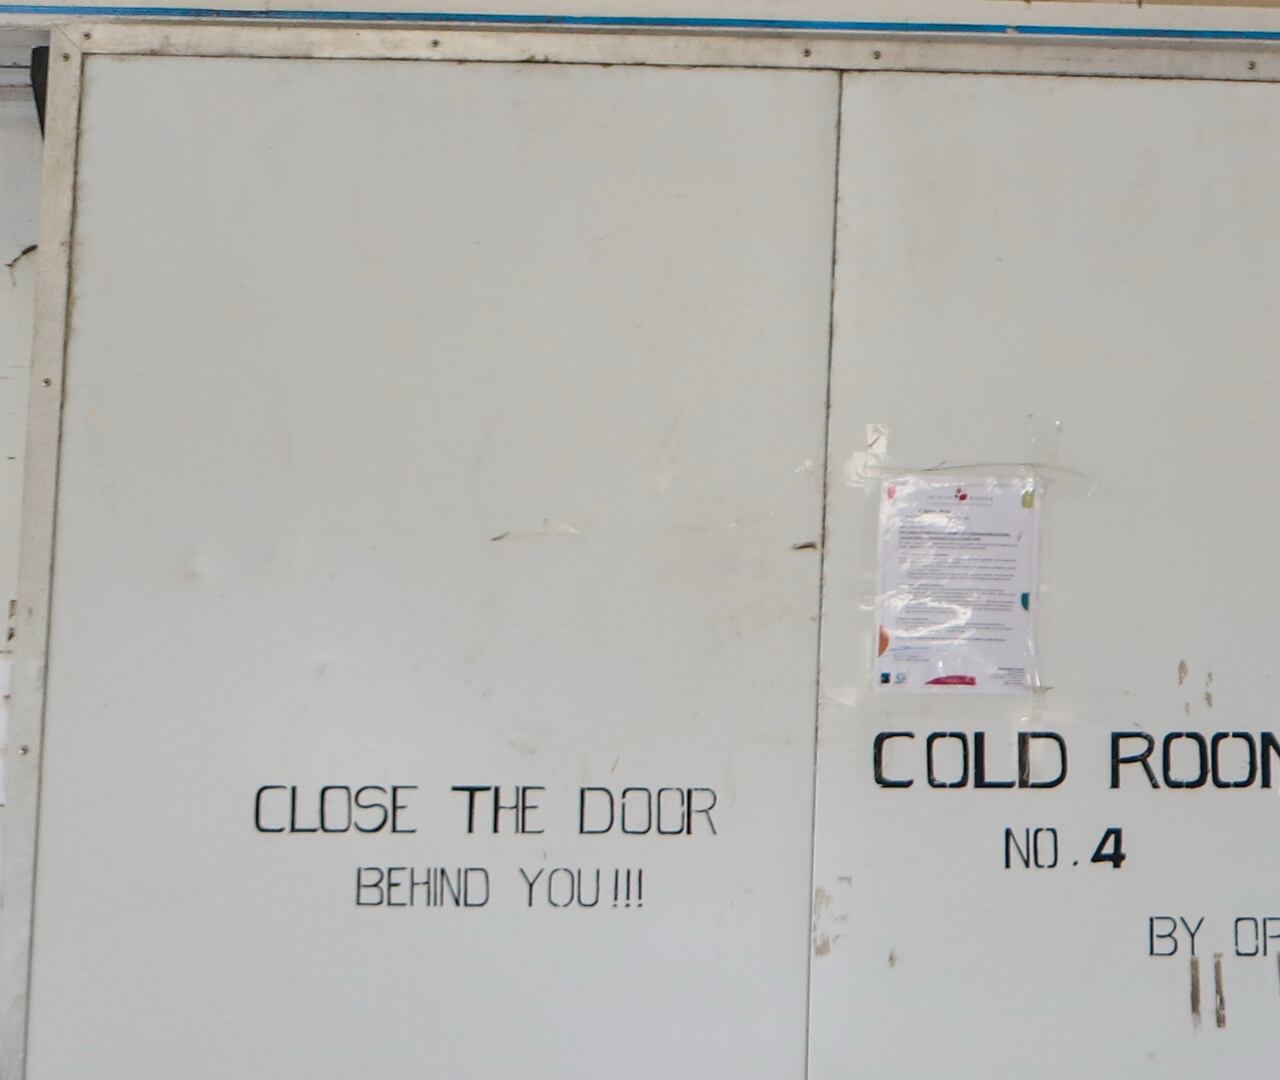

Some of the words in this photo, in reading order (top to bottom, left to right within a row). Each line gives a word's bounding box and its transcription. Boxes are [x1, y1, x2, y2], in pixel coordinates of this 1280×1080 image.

[873, 731, 1068, 789] COLD
[254, 784, 419, 834] CLOSE
[451, 785, 546, 834] THE
[578, 786, 718, 836] DOOR
[355, 866, 490, 908] BEHIND
[518, 867, 645, 909] YOU!!!
[1149, 916, 1205, 956] BY
